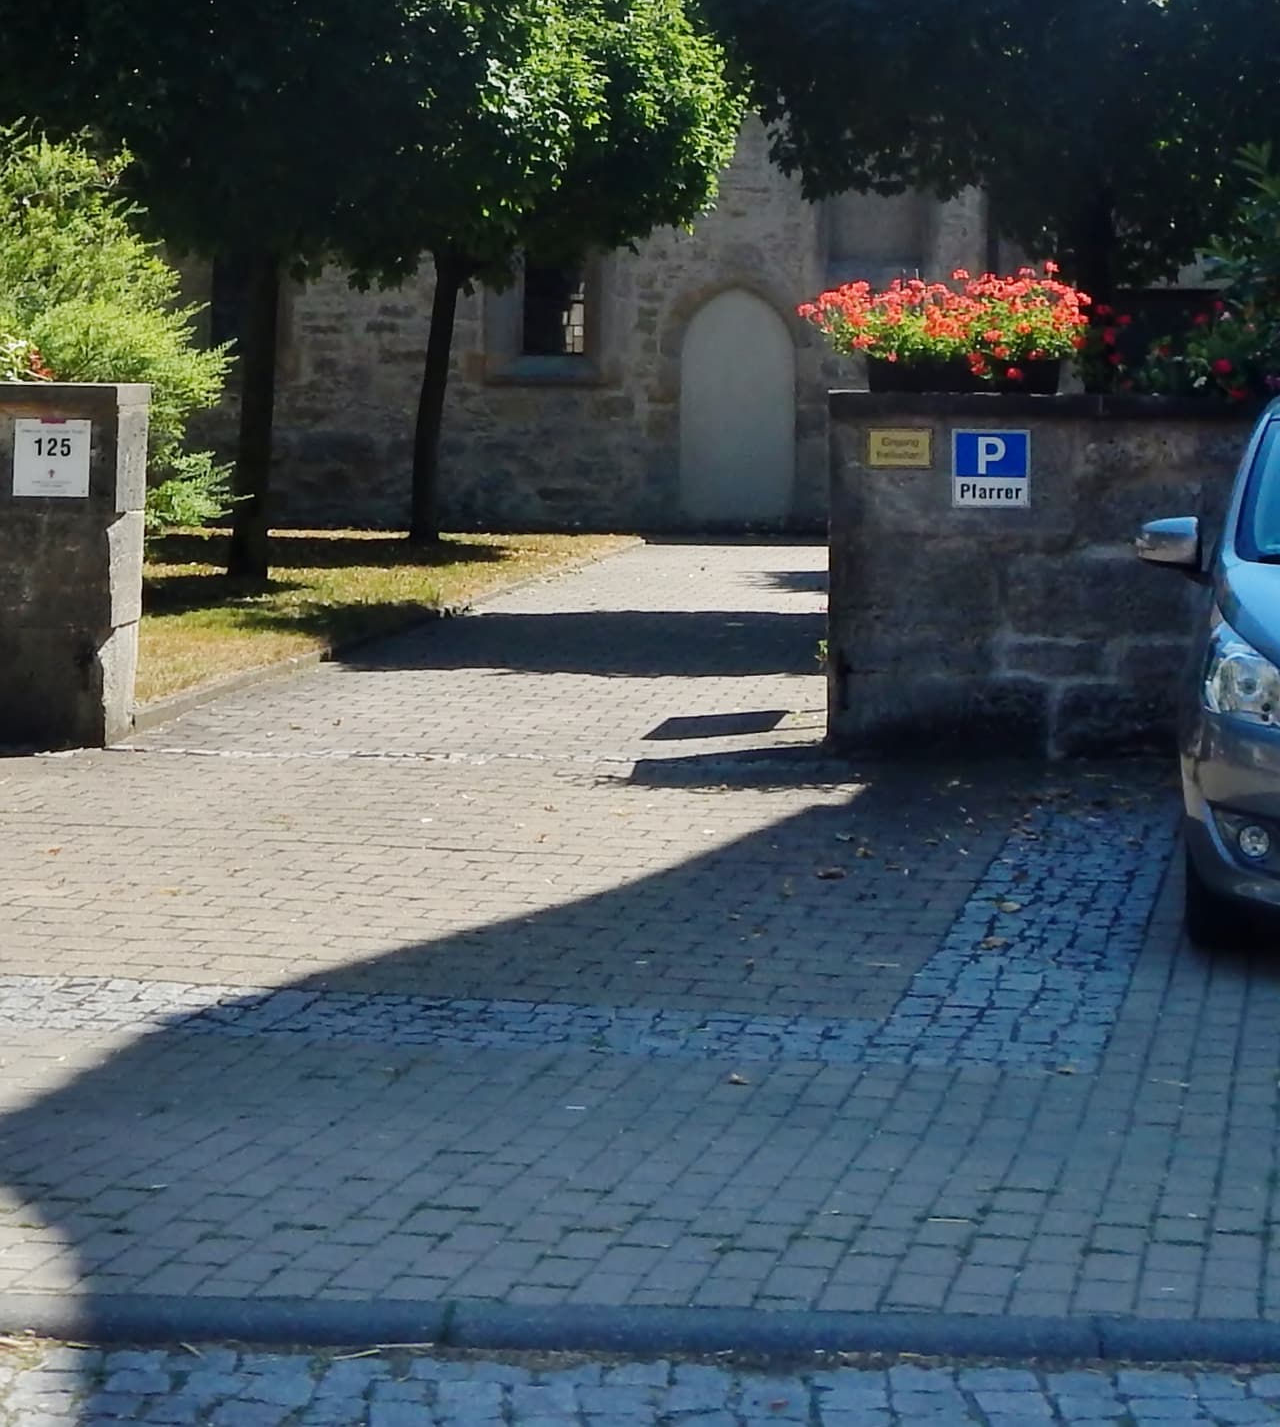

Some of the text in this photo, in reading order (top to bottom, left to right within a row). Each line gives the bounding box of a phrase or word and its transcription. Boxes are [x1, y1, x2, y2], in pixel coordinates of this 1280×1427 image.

[34, 437, 71, 457] 125
[977, 436, 1006, 475] P
[960, 483, 1023, 499] Pfarrer
